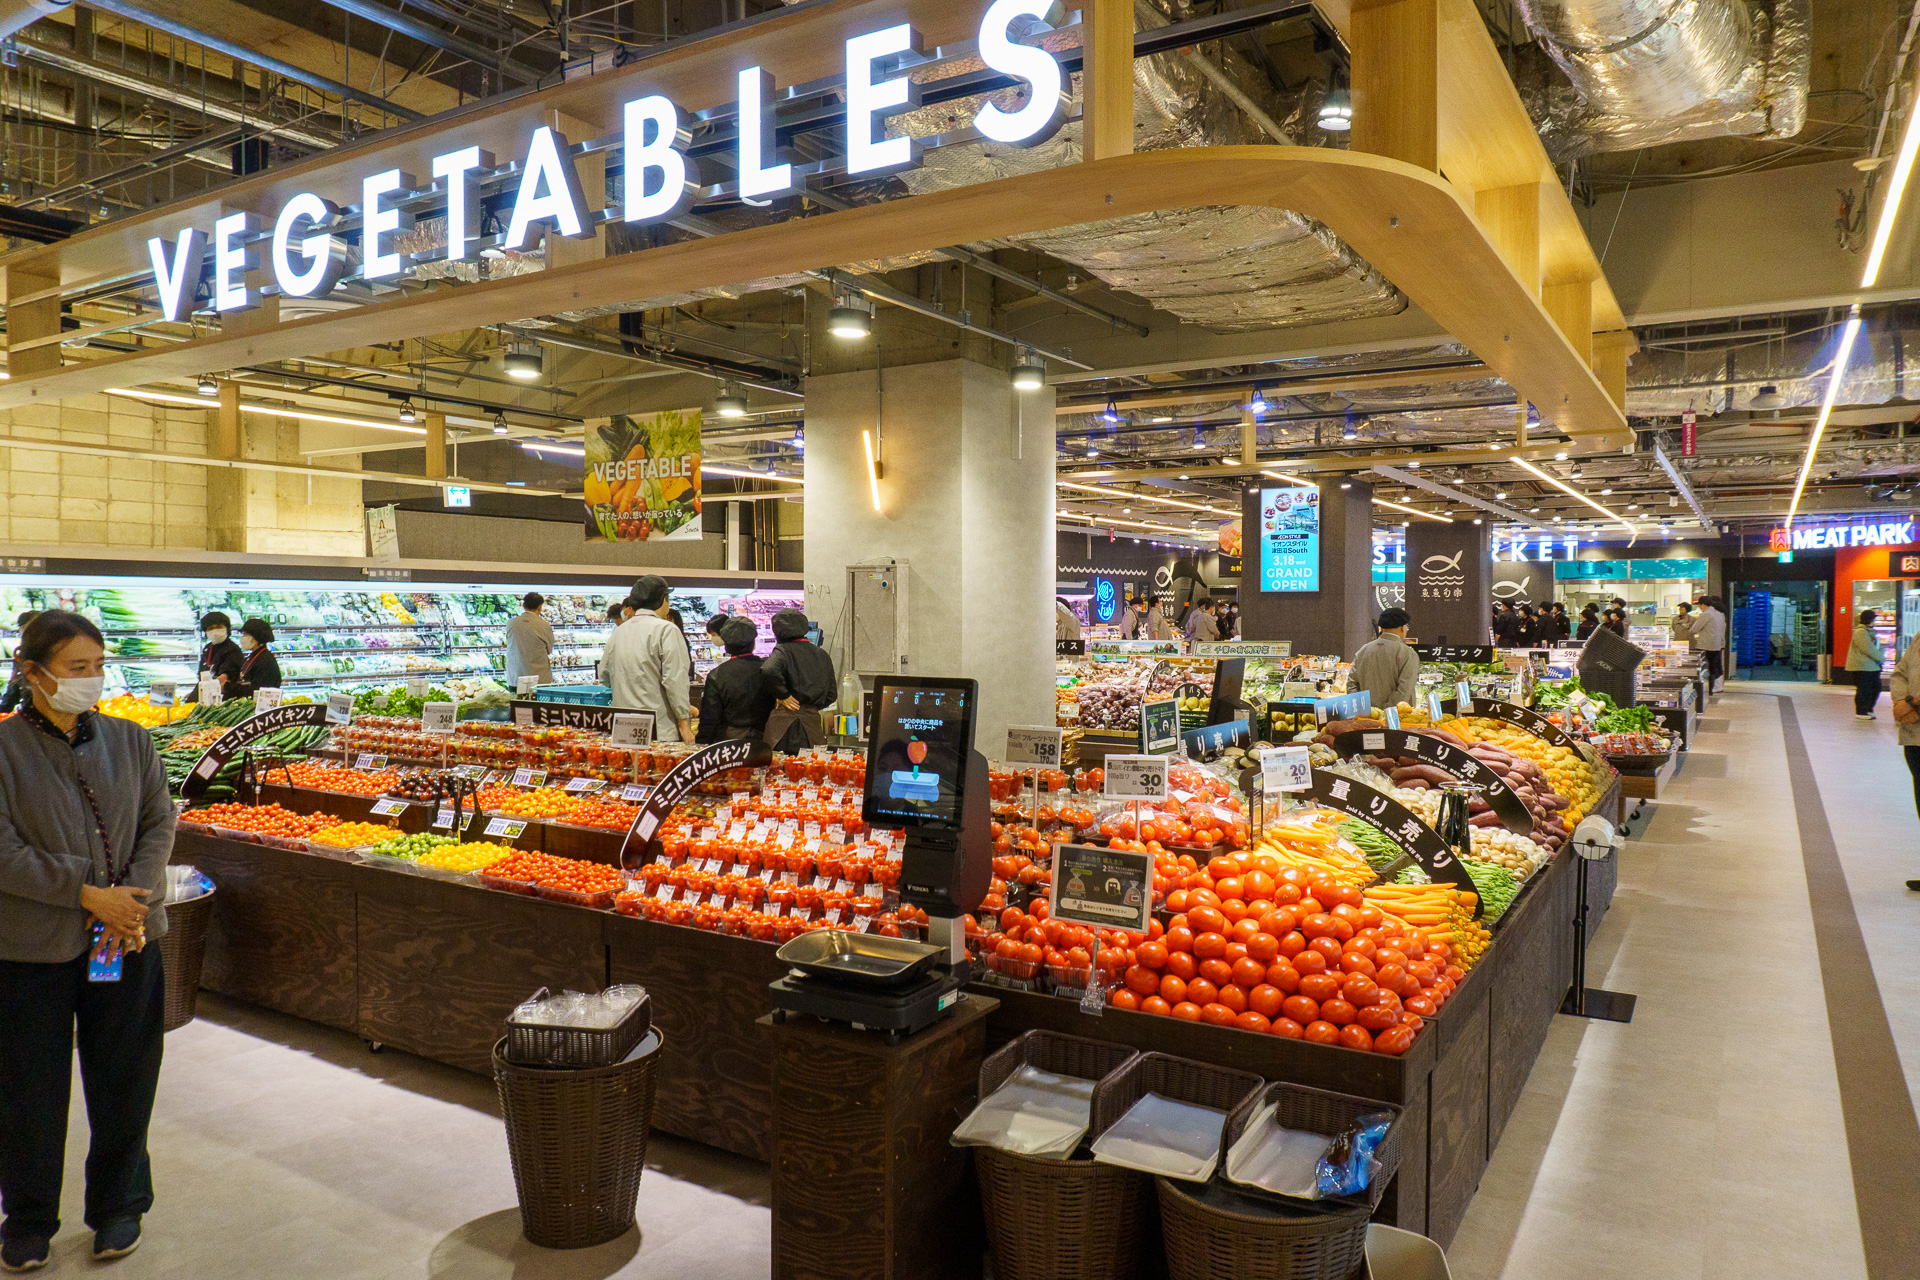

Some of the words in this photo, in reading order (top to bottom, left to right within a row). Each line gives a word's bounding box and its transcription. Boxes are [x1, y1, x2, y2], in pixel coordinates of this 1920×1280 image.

[148, 0, 1062, 322] VEGETABLES
[593, 455, 692, 482] VEGETABLE
[599, 509, 686, 521] 育てた人の、想いが宿っている。
[1793, 526, 1849, 549] MEAT
[1851, 522, 1913, 546] PARK
[1273, 555, 1295, 565] 3.18
[1266, 567, 1313, 578] GRAND
[1271, 580, 1307, 590] OPEN
[1213, 645, 1270, 655] 千葉の有機野菜
[1410, 646, 1483, 658] ーガニック
[1564, 650, 1577, 658] 598
[1332, 695, 1366, 717] バラ売り
[439, 714, 453, 724] 248
[1488, 703, 1567, 746] バラ売り
[216, 705, 317, 755] ミニトマトバイキング
[632, 728, 648, 739] 350
[1022, 734, 1059, 743] フルーツトマト
[1034, 743, 1056, 757] 158
[1290, 763, 1306, 777] 20
[1404, 735, 1505, 796] 量り売り
[655, 742, 751, 808] ミニトマトバイキング
[1139, 773, 1162, 787] 30
[1329, 778, 1453, 868] 量り売り
[1345, 804, 1359, 814] Sold
[1358, 811, 1366, 819] by
[1365, 815, 1383, 828] weight
